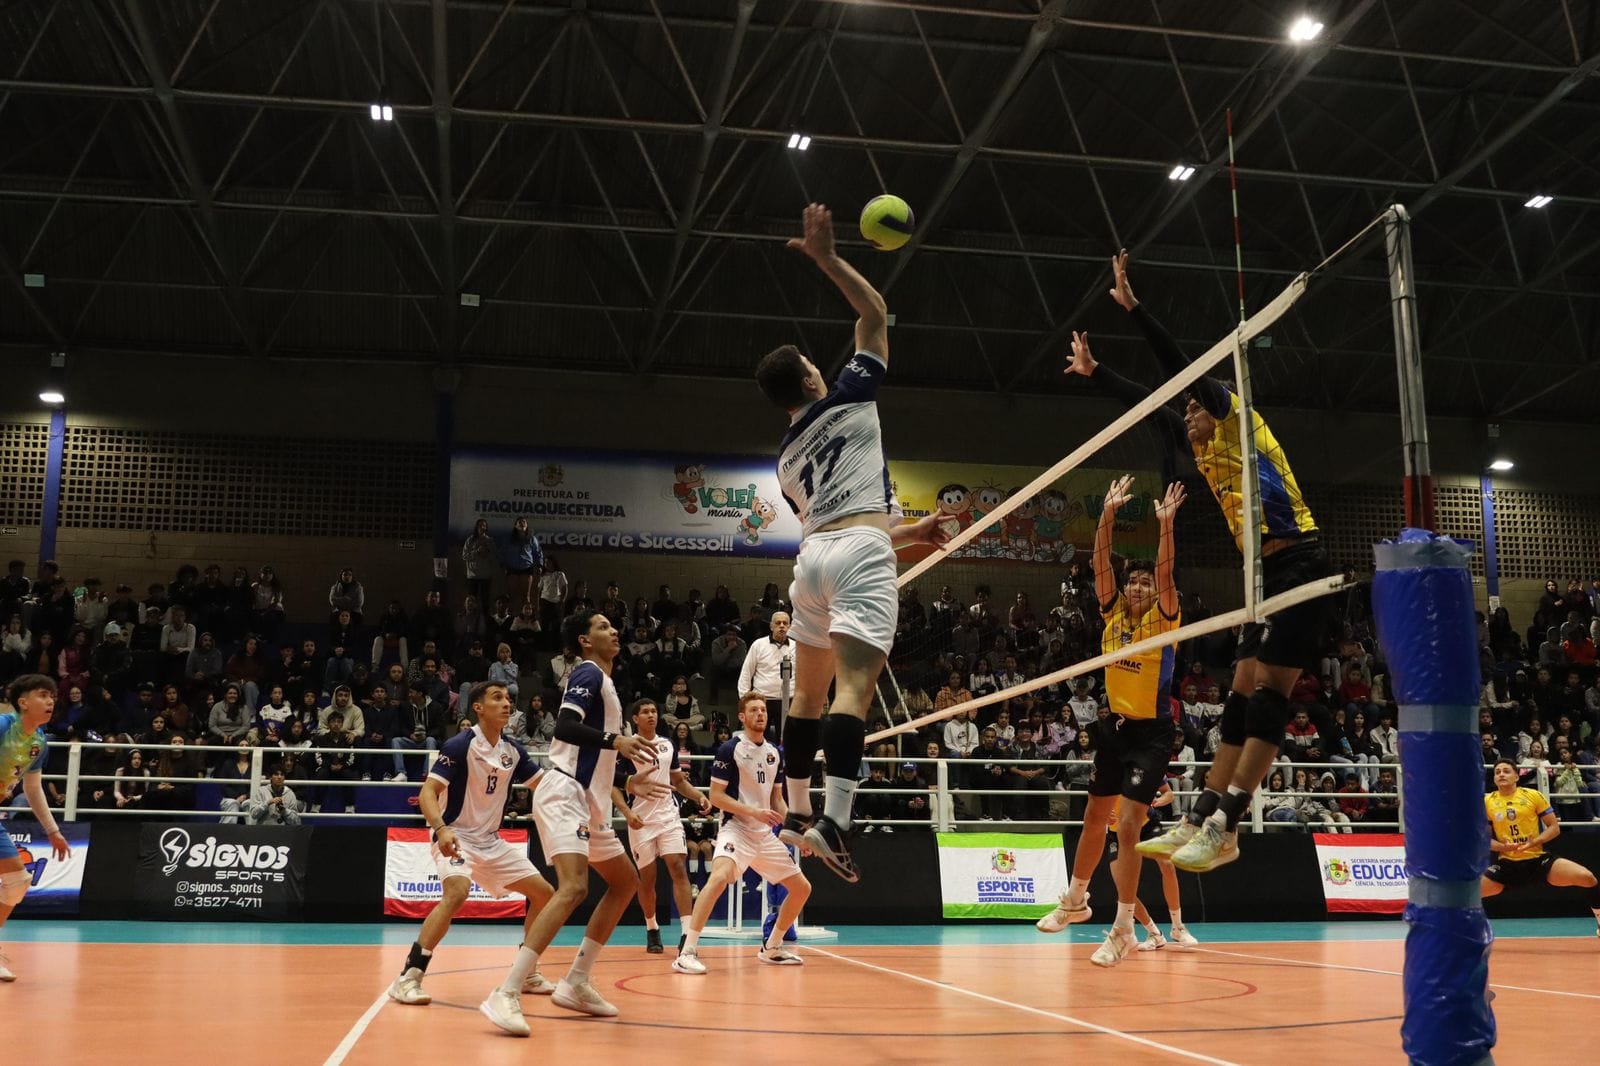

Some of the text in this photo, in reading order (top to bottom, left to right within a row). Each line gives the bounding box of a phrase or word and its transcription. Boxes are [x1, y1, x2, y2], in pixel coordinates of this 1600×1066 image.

[799, 435, 847, 500] 17
[513, 488, 590, 500] PREFEITURA DE
[475, 500, 626, 517] ITAQUAQUECETUBA
[707, 507, 743, 518] mania
[903, 509, 930, 517] ETUBA
[535, 531, 734, 551] arceria de Sucesso!!!
[487, 775, 498, 791] 13
[757, 770, 766, 784] 10
[1509, 824, 1520, 836] 15
[215, 870, 286, 882] SPORTS
[189, 881, 264, 895] signos_sports
[977, 881, 1034, 893] ESPORTE
[194, 896, 263, 908] 3527-4711
